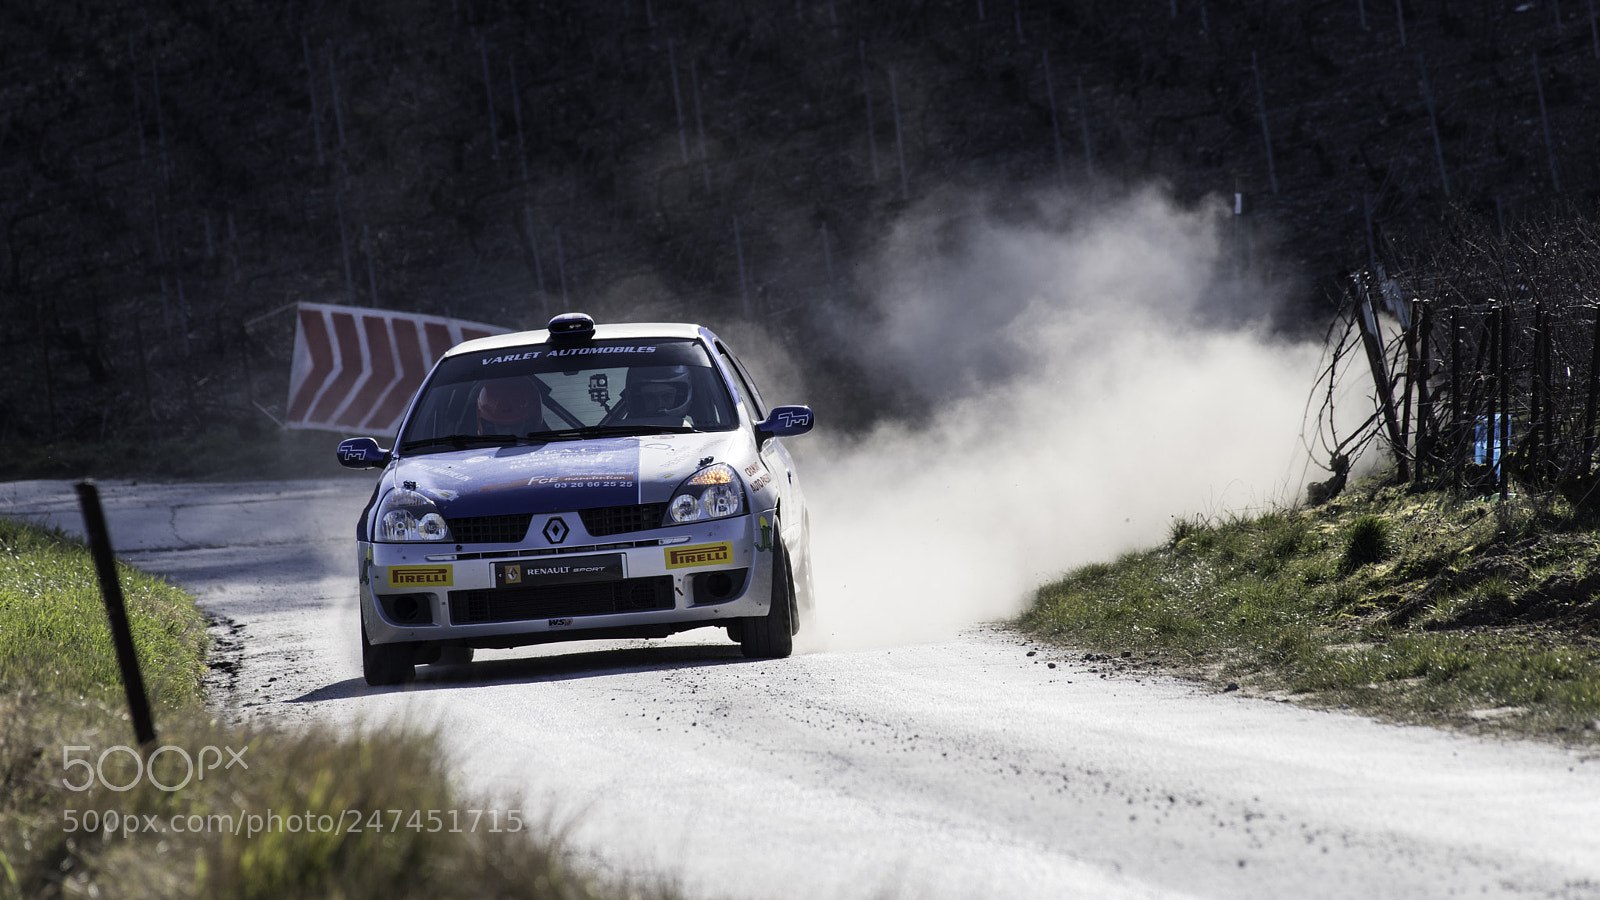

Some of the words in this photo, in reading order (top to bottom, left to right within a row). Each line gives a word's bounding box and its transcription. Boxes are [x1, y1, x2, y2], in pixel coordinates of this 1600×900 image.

[482, 352, 542, 365] VARLET
[546, 346, 656, 357] AUTOMOBILES
[670, 546, 728, 565] PIRELLI
[392, 568, 448, 584] PIRELLI
[527, 566, 570, 576] RENAULT
